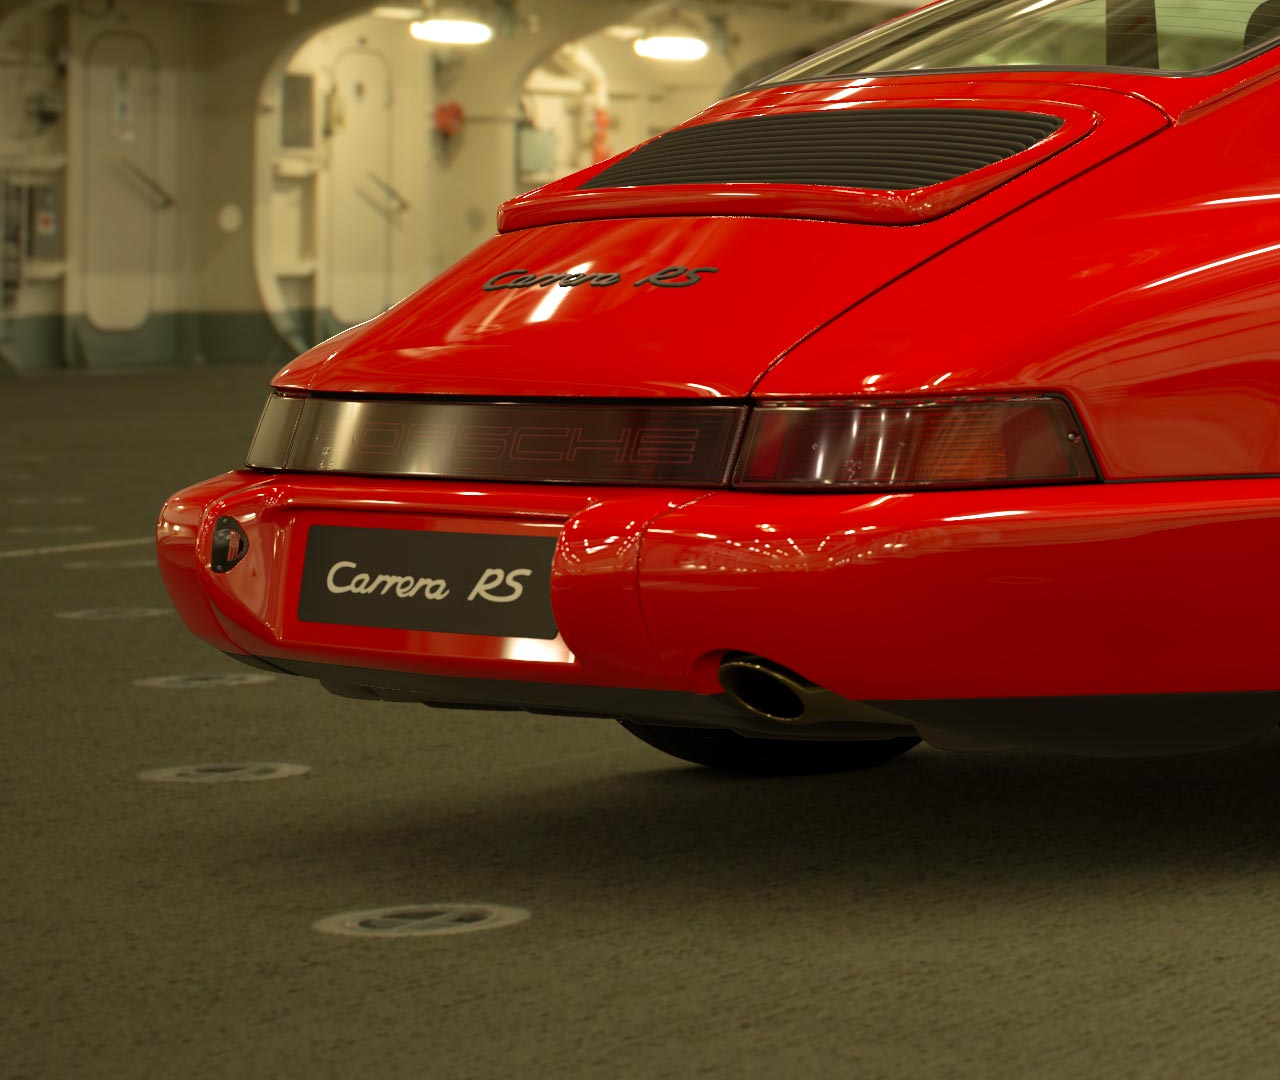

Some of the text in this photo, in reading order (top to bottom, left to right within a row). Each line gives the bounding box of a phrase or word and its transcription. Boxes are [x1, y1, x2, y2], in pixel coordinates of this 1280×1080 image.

[482, 265, 719, 291] Carrera RS
[313, 421, 699, 464] PORSCHE
[326, 560, 533, 603] Carrera RS
